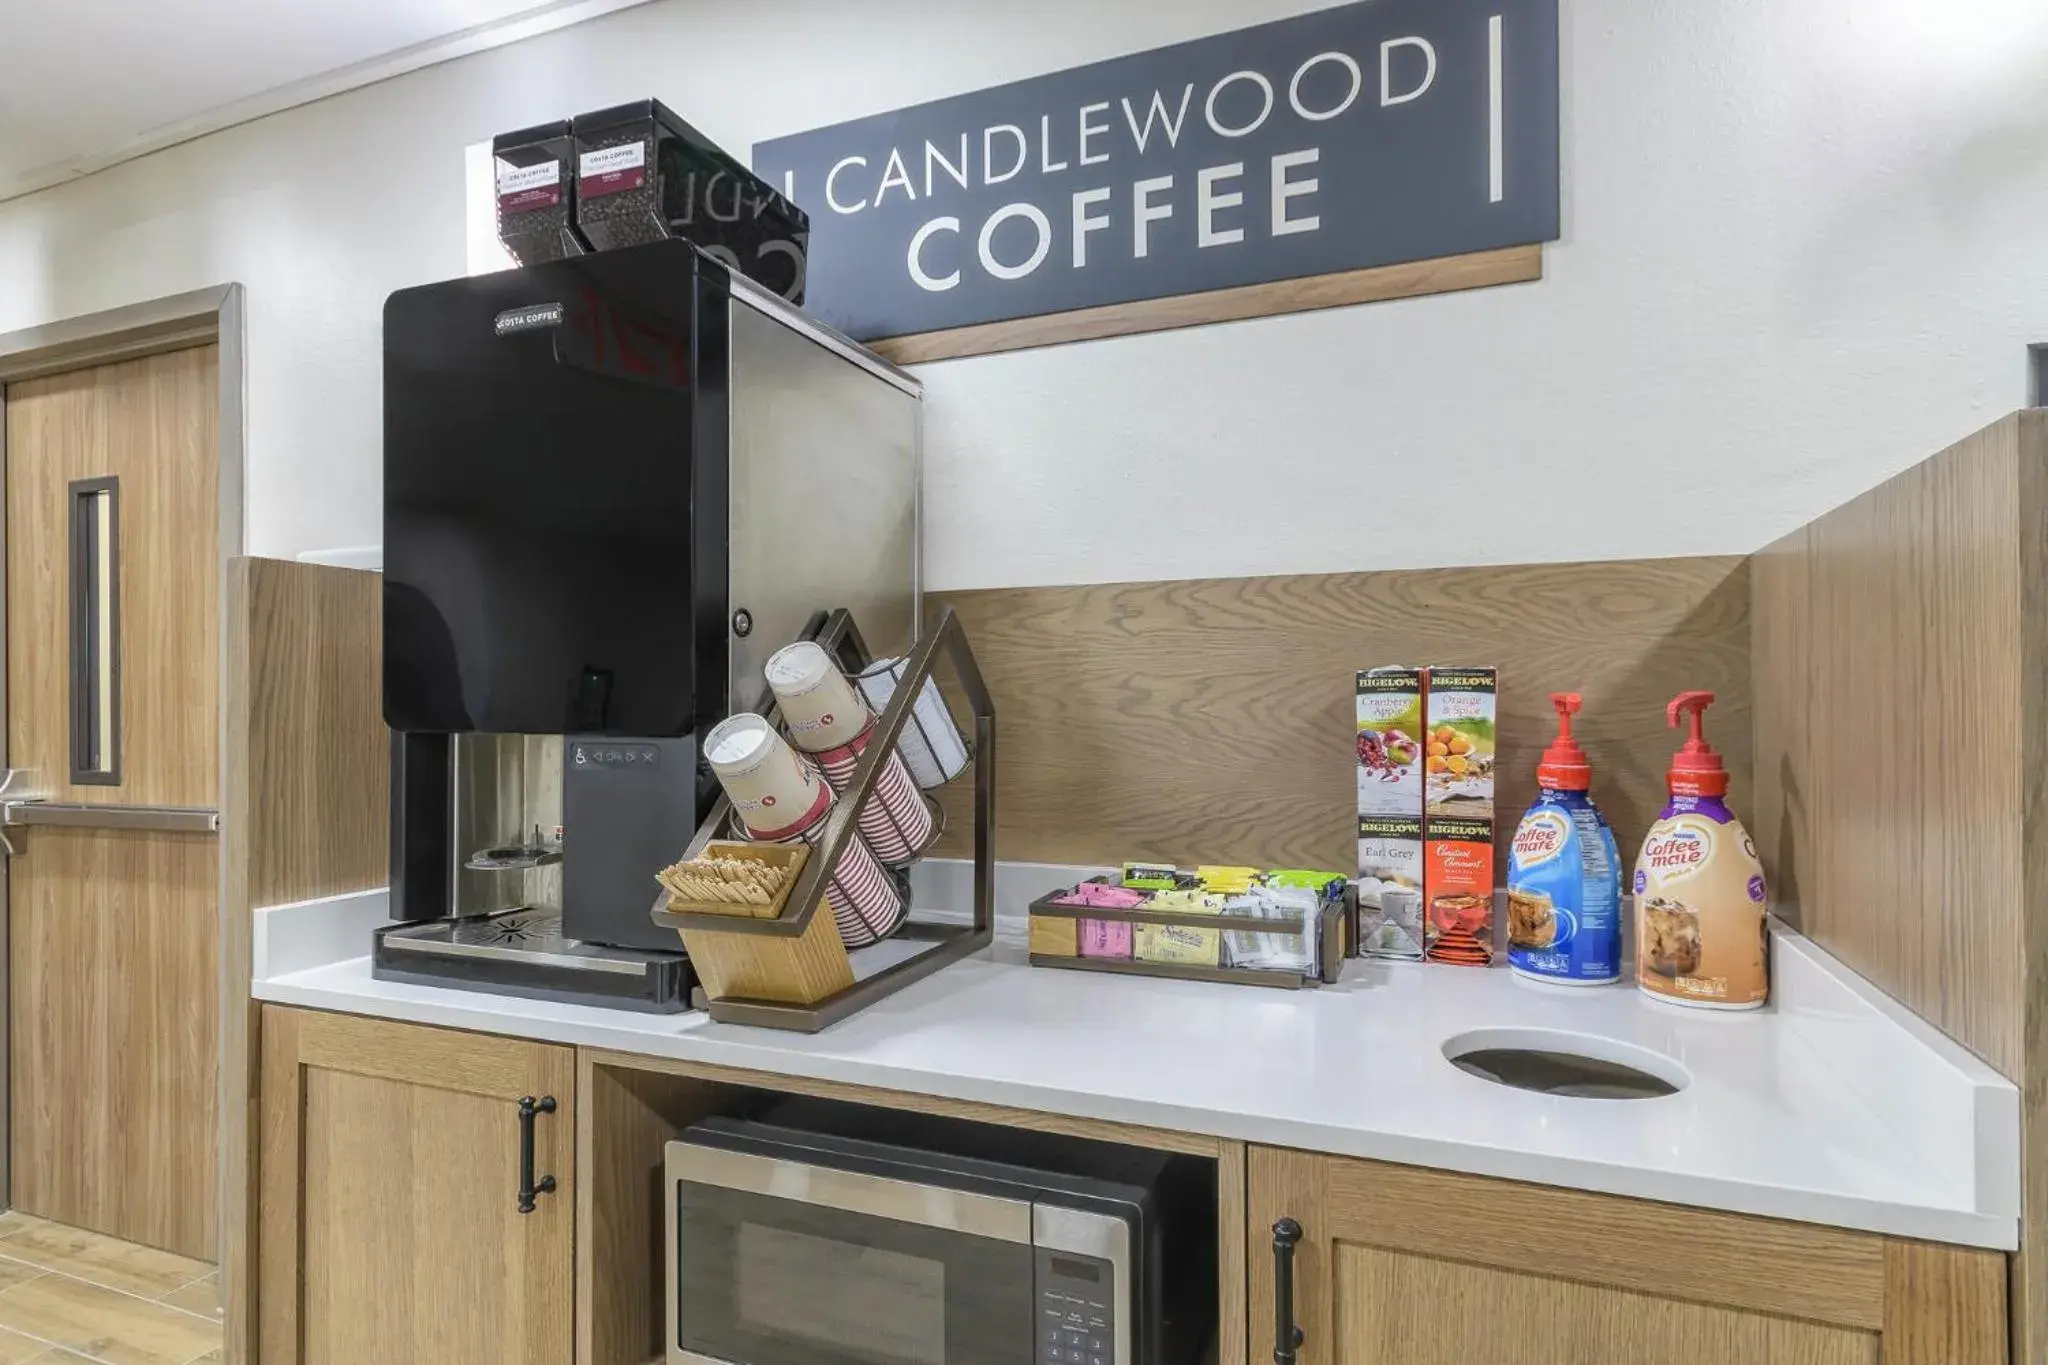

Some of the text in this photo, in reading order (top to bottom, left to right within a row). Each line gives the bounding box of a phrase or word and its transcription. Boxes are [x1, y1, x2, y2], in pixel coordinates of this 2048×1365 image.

[826, 36, 1437, 214] CANDLEWOOD
[907, 147, 1320, 292] COFFEE
[499, 310, 558, 328] COSTA COFFEE
[1361, 823, 1420, 832] BIGELOW
[1429, 825, 1490, 835] BIGELOW
[1366, 847, 1414, 860] Earl Grey
[1516, 840, 1554, 853] mate
[1646, 837, 1701, 857] Coffee
